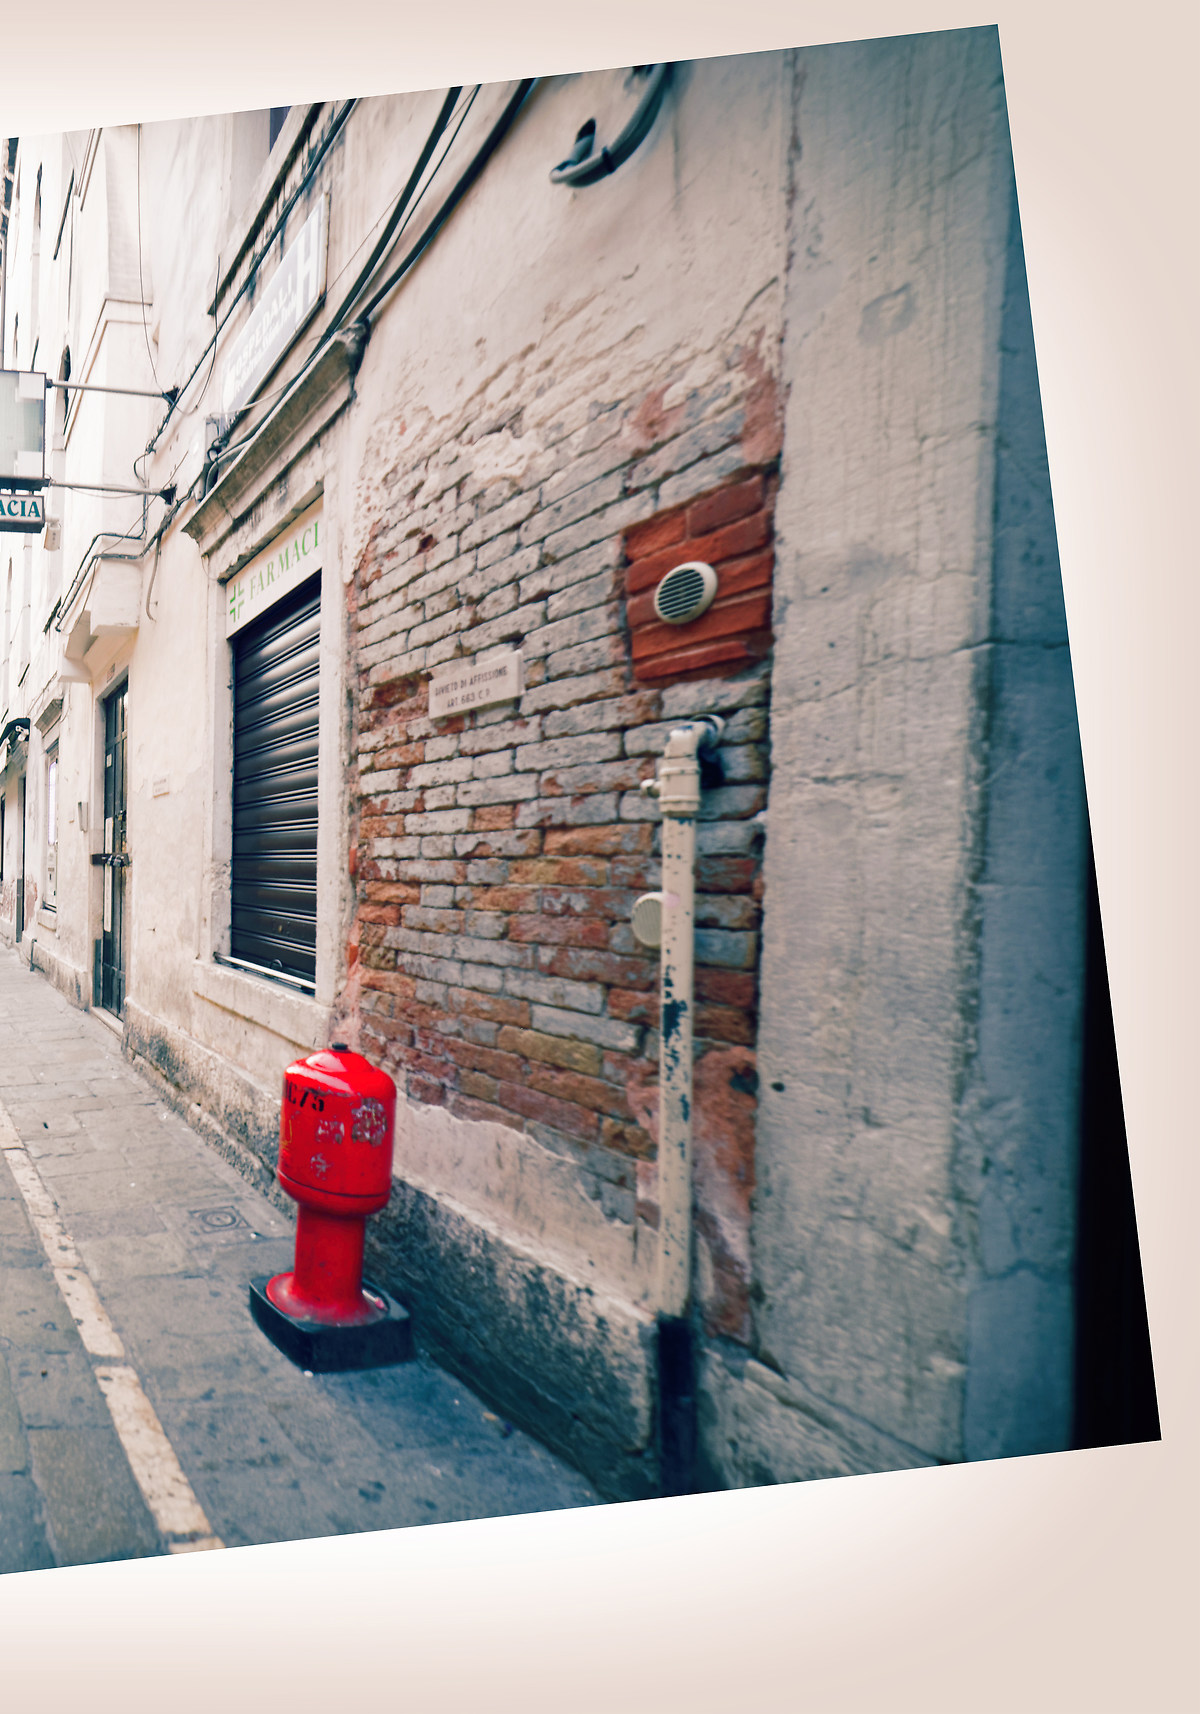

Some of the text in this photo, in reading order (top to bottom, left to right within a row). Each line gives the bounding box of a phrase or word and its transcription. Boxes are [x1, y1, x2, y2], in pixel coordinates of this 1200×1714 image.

[296, 209, 319, 323] H
[460, 680, 467, 689] DI
[469, 665, 507, 686] AFFISSIONE
